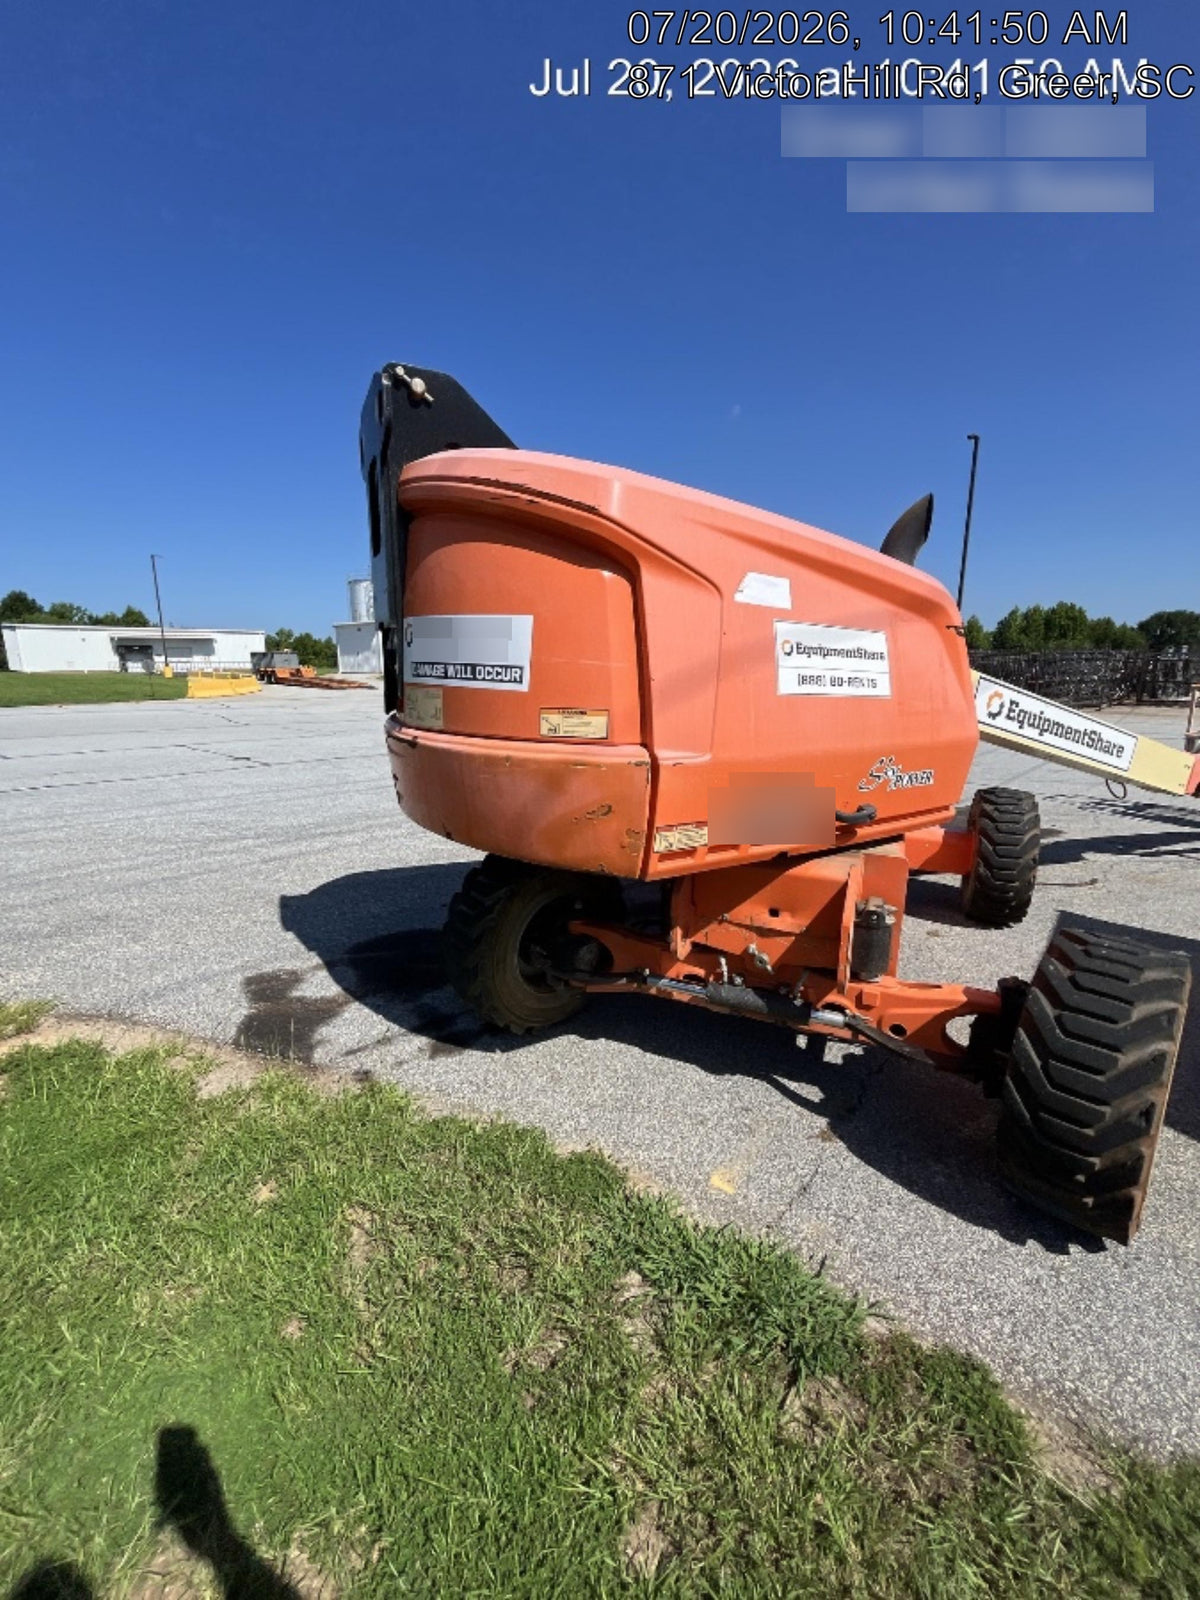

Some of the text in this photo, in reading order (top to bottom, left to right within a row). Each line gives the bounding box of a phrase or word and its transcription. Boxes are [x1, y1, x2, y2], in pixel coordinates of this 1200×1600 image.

[796, 641, 885, 661] EquipmentShare
[413, 663, 521, 682] AMAGE WILL OCCUR
[1005, 699, 1126, 759] EquipmentShare
